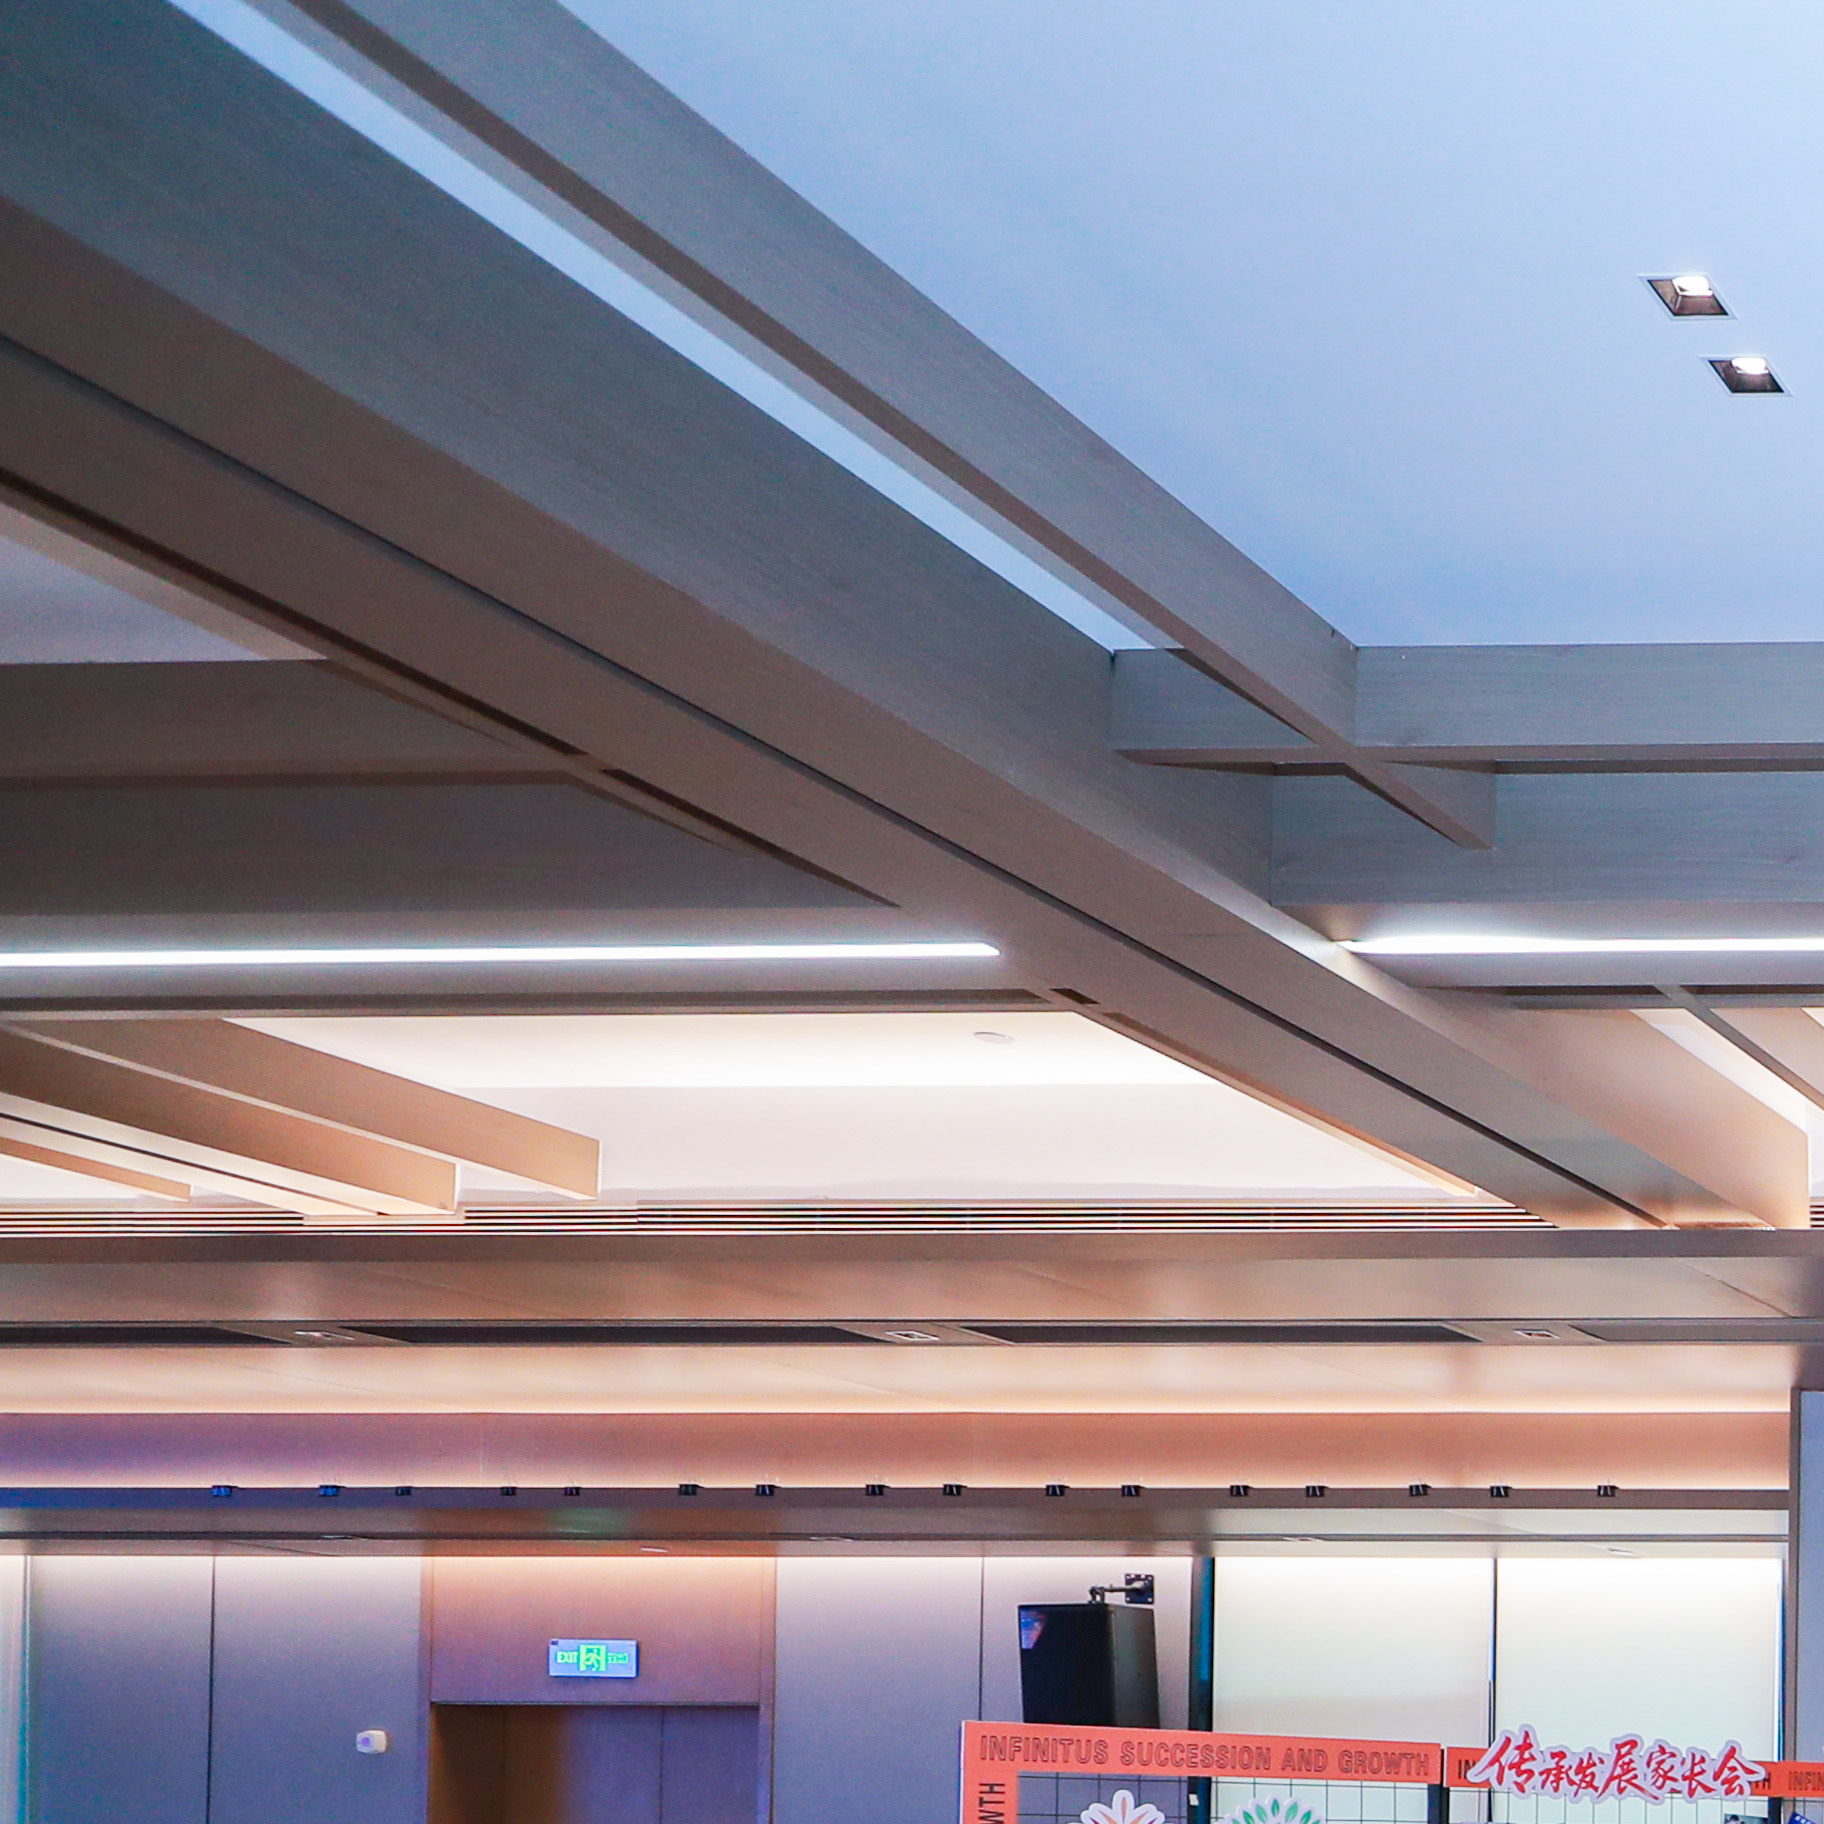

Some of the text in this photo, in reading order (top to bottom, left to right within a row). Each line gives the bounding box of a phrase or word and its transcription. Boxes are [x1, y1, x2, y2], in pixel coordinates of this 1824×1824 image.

[557, 1651, 578, 1664] EXIT
[980, 1735, 1108, 1765] INFINITUS
[1121, 1741, 1271, 1770] SUCCESSION
[1281, 1748, 1328, 1773] AND
[1338, 1751, 1429, 1777] GROWTH
[1479, 1728, 1757, 1799] 传承发展家长会
